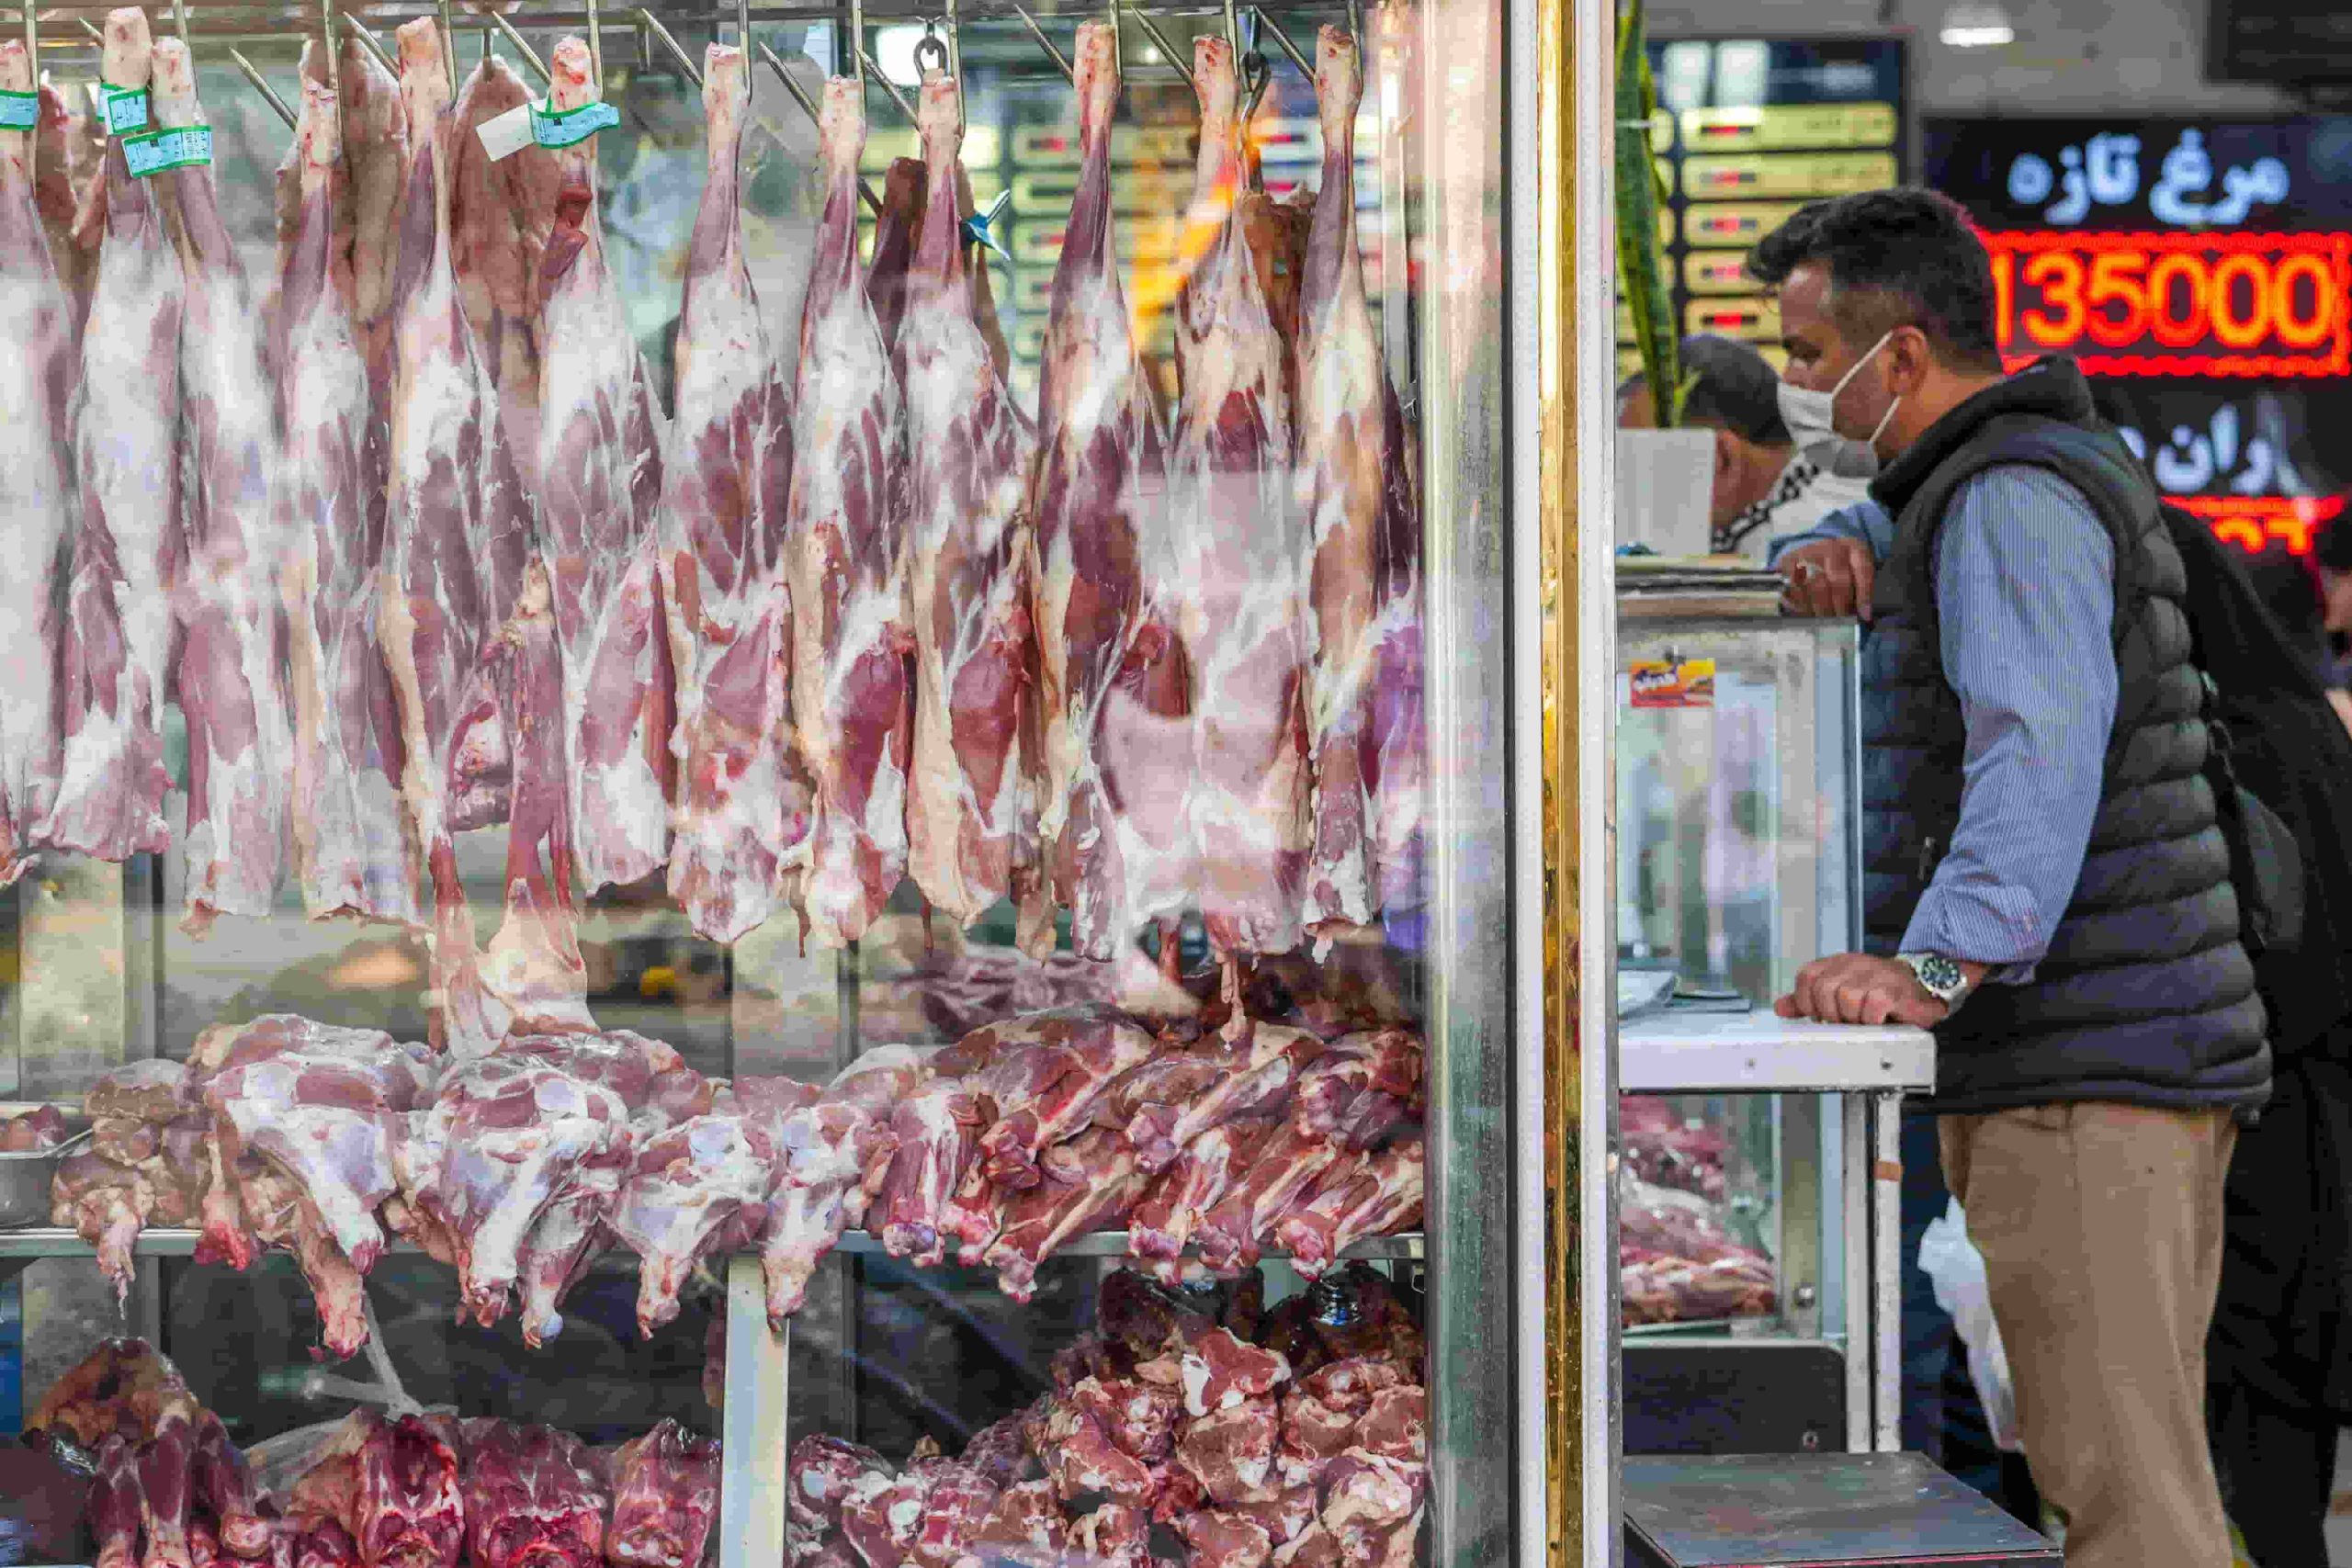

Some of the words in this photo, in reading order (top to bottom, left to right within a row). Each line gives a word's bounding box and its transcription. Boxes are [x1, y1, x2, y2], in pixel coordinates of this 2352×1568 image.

[2007, 132, 2142, 224] تازه
[2149, 128, 2290, 224] مرغ
[1991, 251, 2334, 347] 135000
